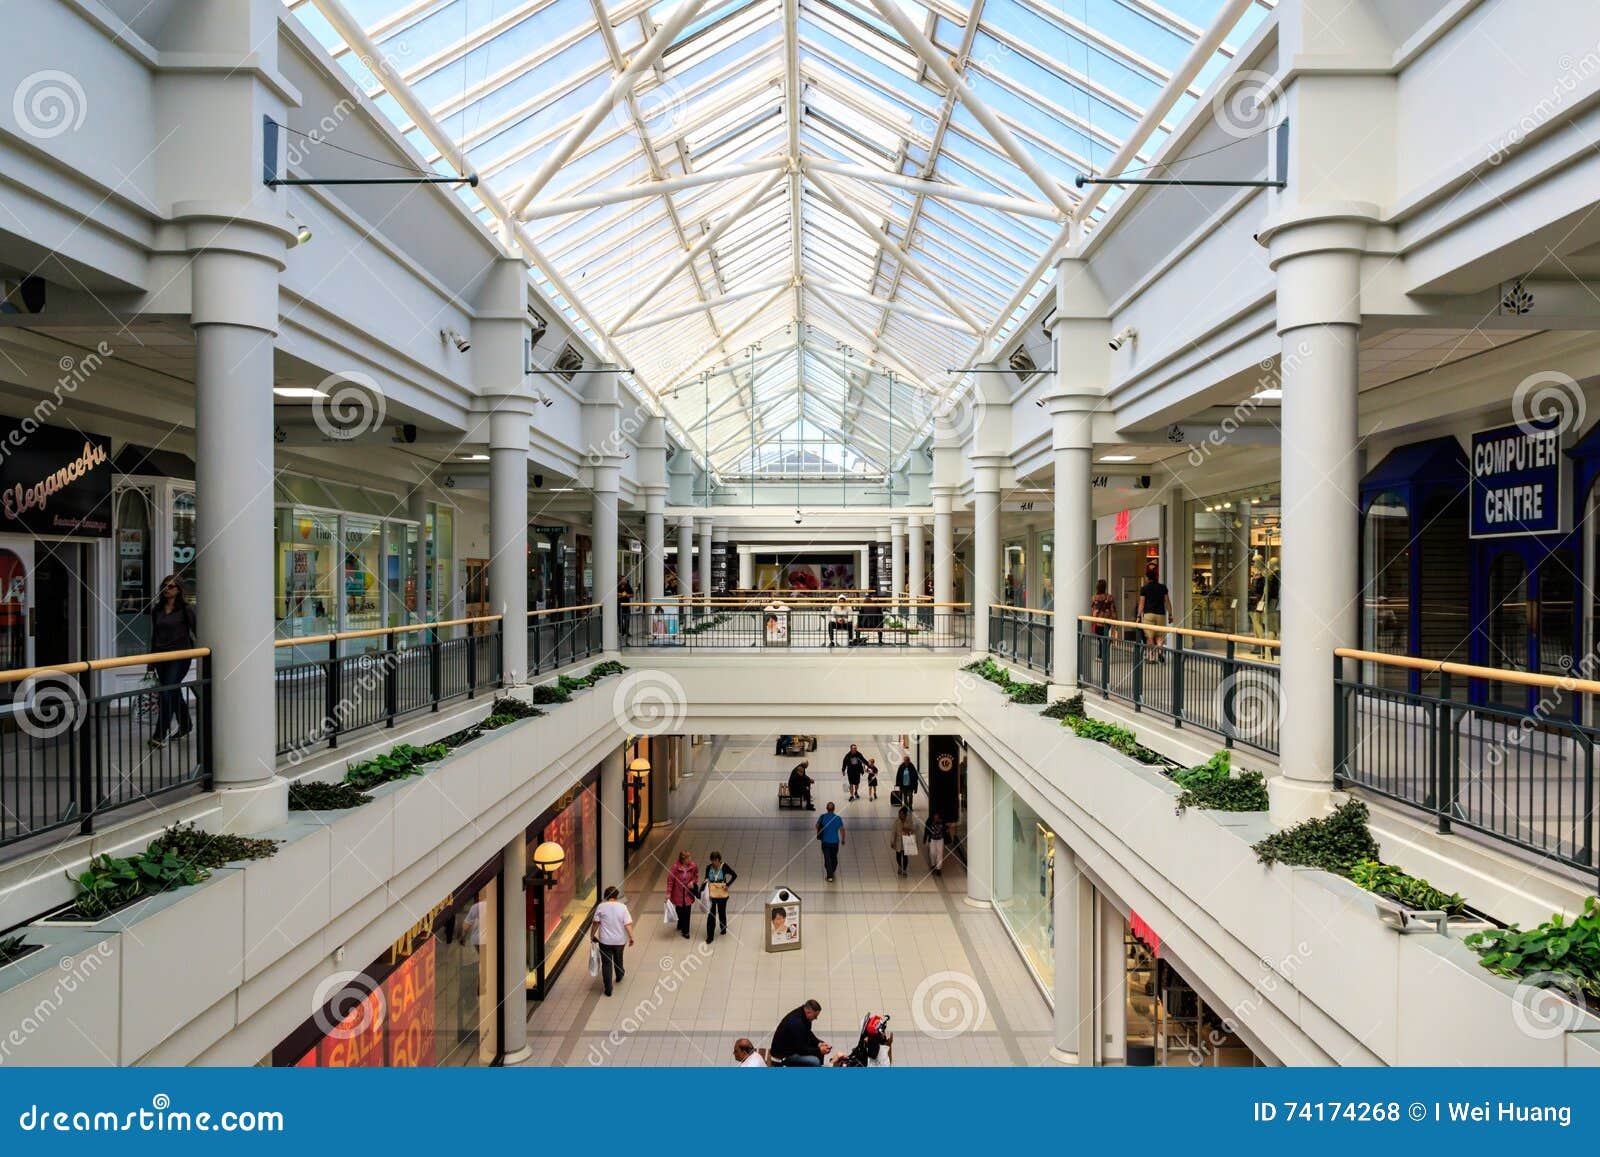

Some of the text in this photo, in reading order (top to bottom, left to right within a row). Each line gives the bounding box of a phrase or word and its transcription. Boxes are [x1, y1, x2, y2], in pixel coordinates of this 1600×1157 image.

[1475, 430, 1556, 477] COMPUTER
[1485, 484, 1543, 524] CENTRE
[391, 956, 434, 1023] SALE
